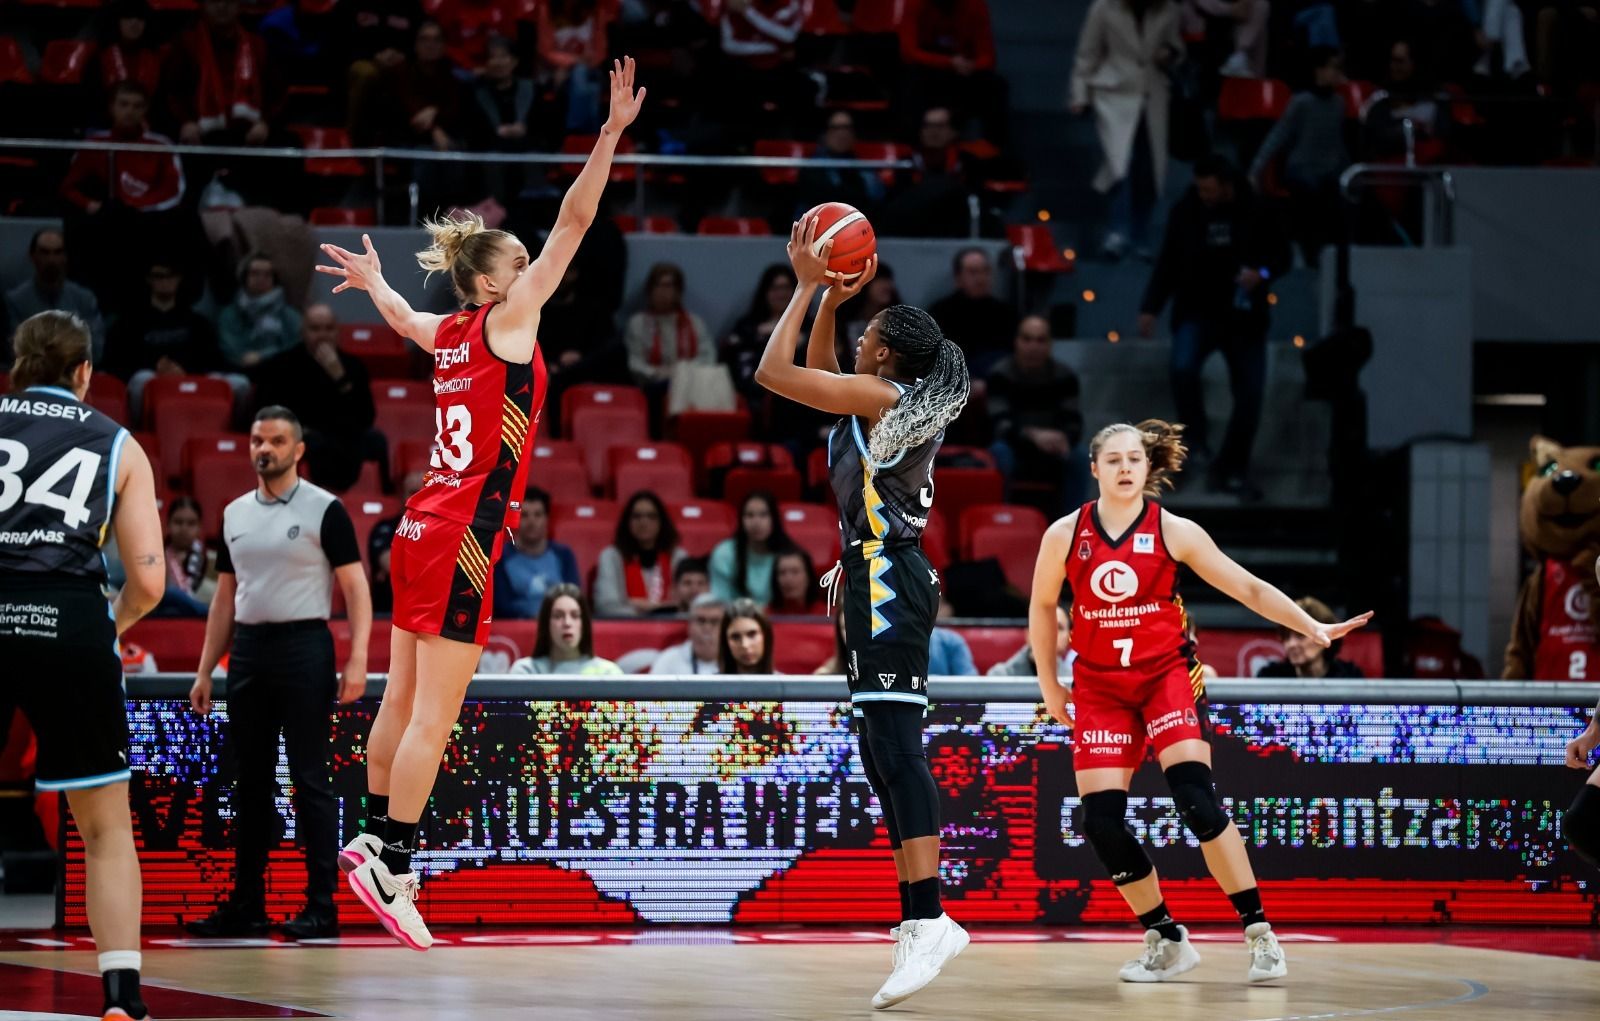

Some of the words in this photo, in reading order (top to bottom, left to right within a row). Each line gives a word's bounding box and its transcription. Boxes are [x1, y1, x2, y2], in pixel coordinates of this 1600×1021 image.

[0, 398, 92, 422] MASSEY
[6, 603, 59, 616] Fundación
[31, 613, 58, 628] Díaz
[1098, 618, 1141, 629] ZARAGOZA
[1113, 637, 1134, 667] 7
[1568, 650, 1587, 679] 2
[1082, 730, 1133, 745] Silken
[1090, 746, 1123, 756] HOTELES
